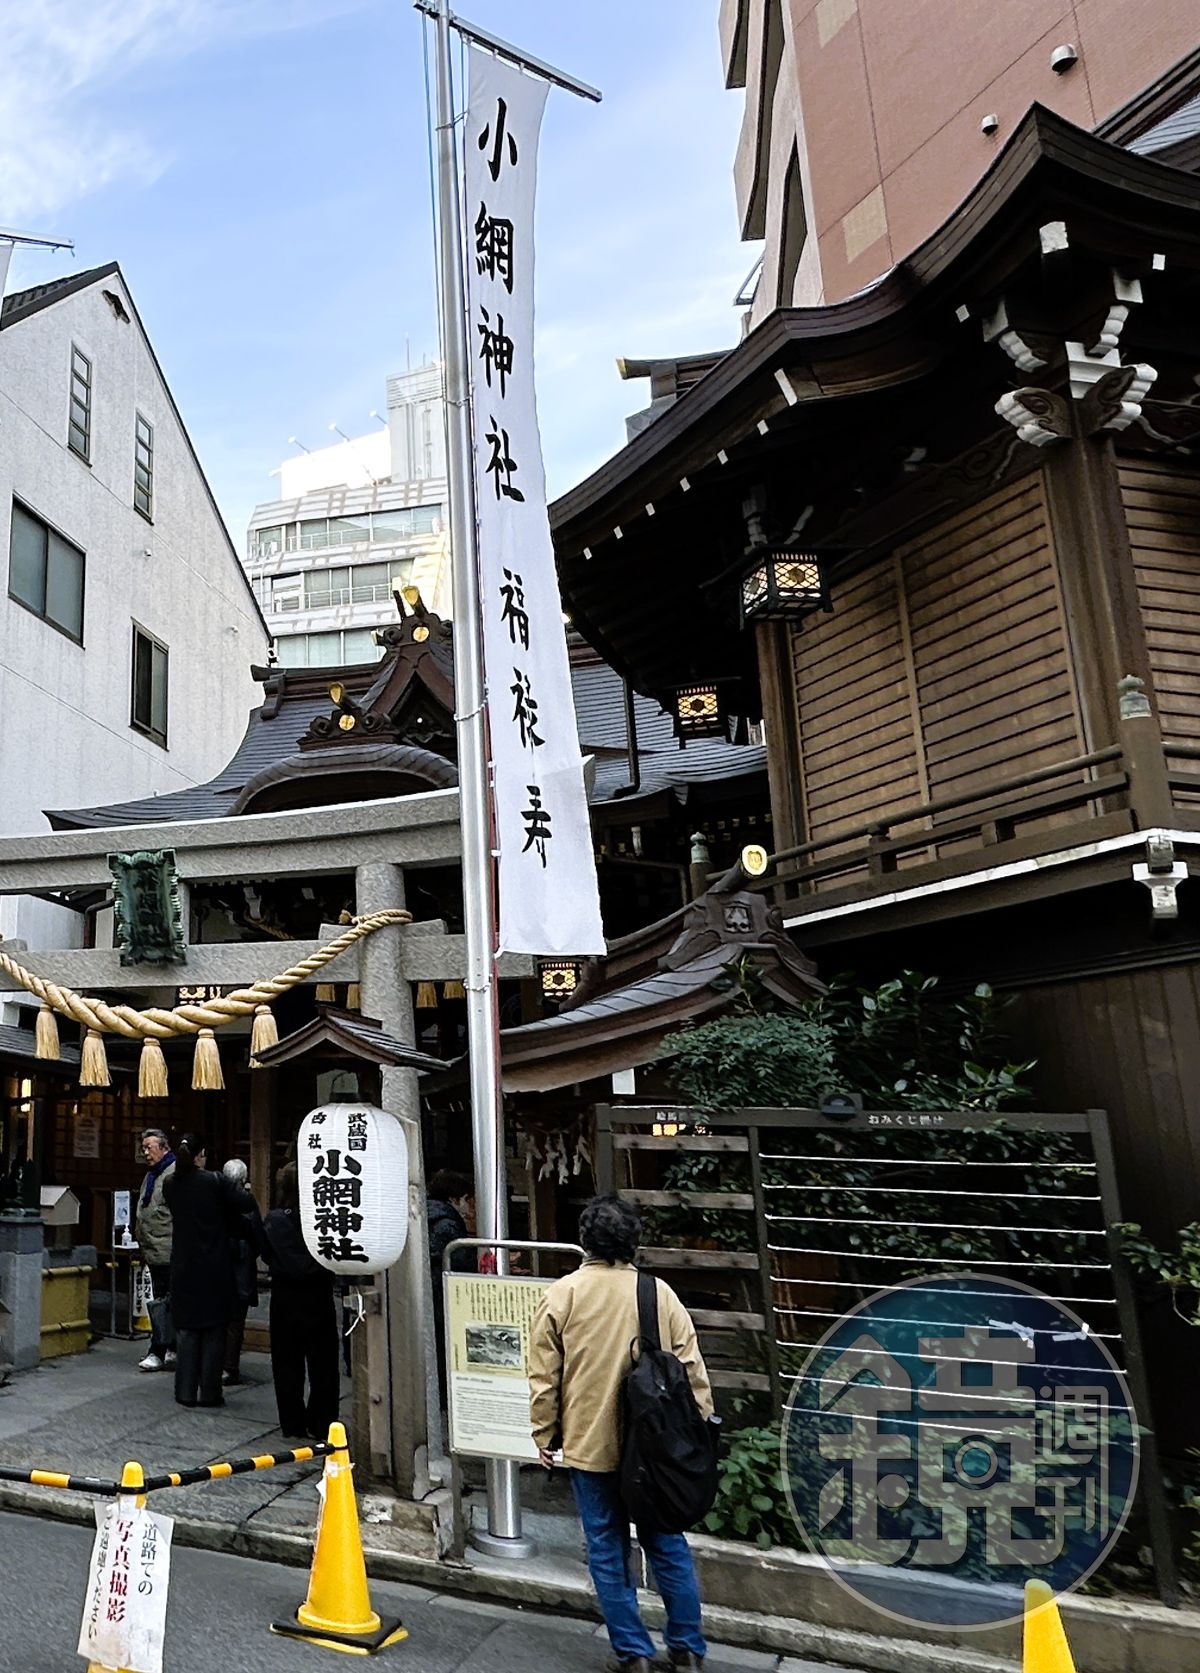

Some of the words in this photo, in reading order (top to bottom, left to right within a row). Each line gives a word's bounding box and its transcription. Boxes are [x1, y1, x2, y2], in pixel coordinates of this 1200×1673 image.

[475, 97, 526, 504] 小網神社
[312, 1149, 369, 1263] 小網神社
[107, 1519, 134, 1623] 写真撮影
[138, 1523, 157, 1596] 道路での
